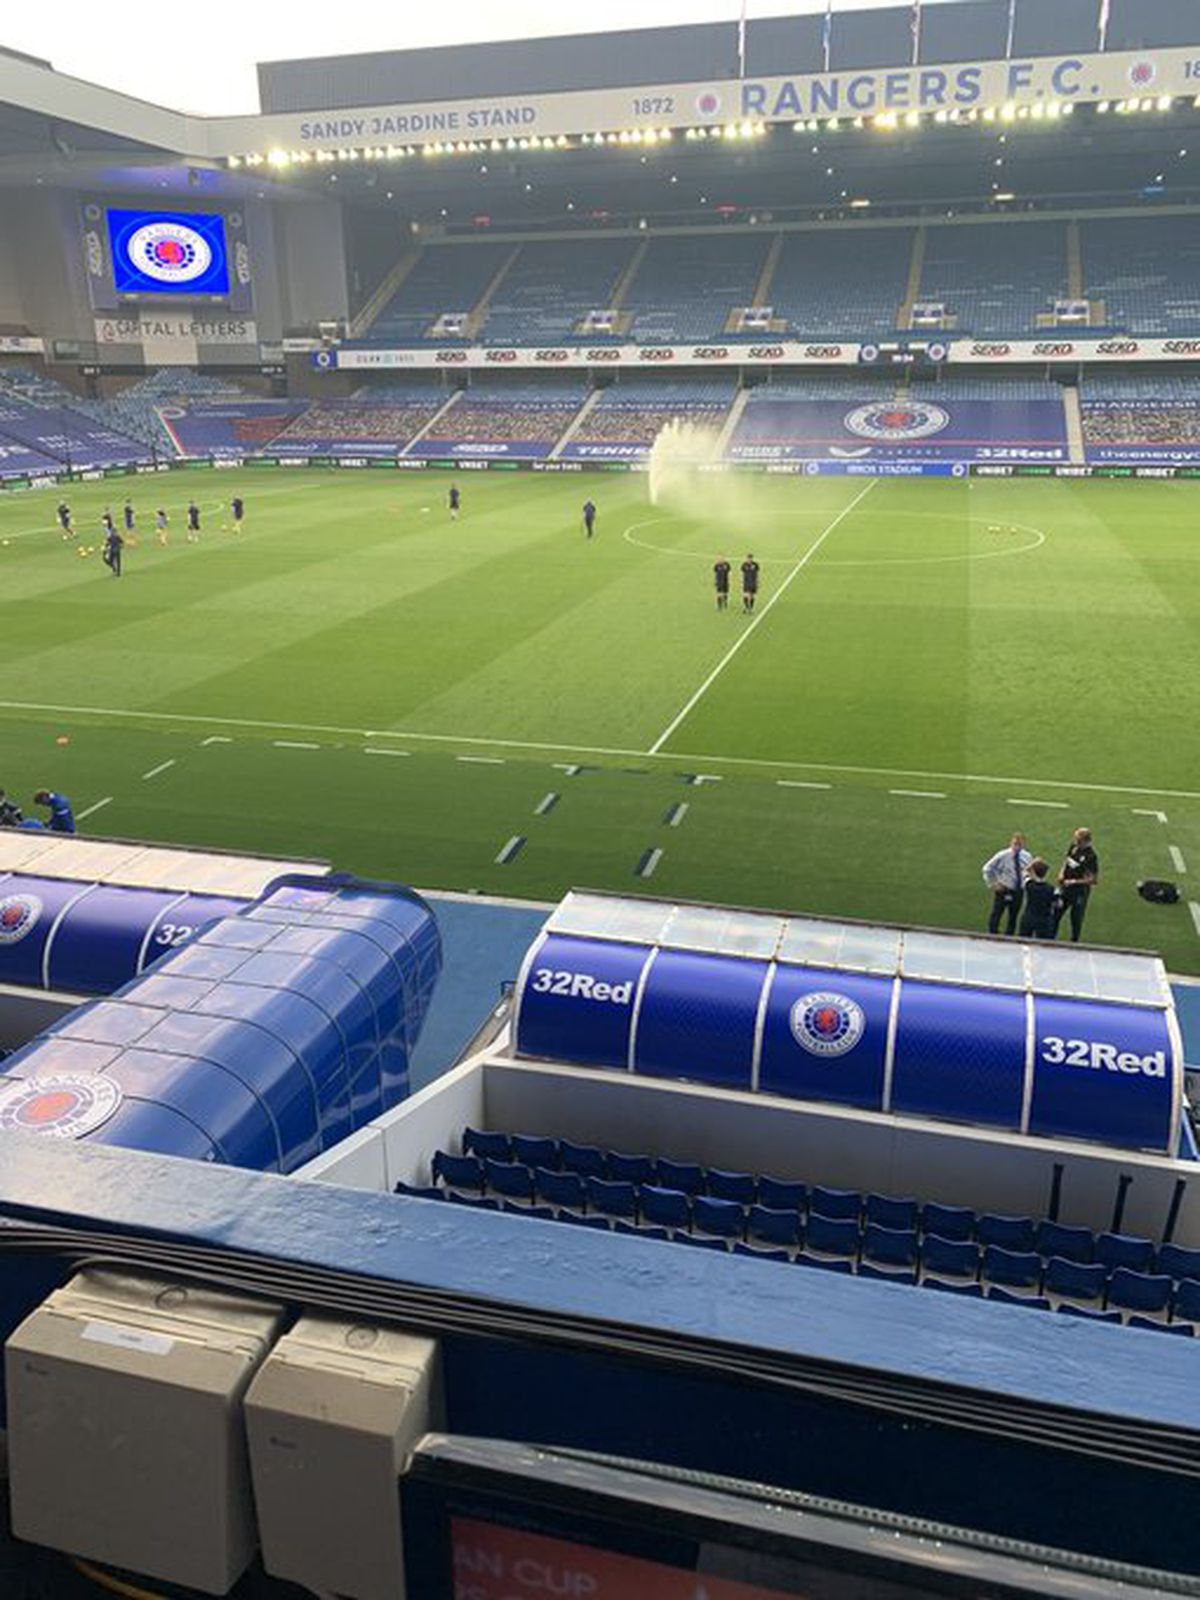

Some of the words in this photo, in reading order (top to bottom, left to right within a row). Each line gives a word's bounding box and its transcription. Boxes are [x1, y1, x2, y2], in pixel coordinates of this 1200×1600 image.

[634, 97, 675, 115] 1872
[742, 67, 982, 117] RANGERS
[1008, 59, 1100, 98] F.C.
[300, 119, 365, 140] SANDY
[371, 111, 460, 135] JARDINE
[466, 106, 537, 128] STAND
[178, 321, 247, 337] LETTERS
[531, 969, 634, 1005] 32Red
[1042, 1036, 1165, 1078] 32Red
[512, 1556, 598, 1596] CUP
